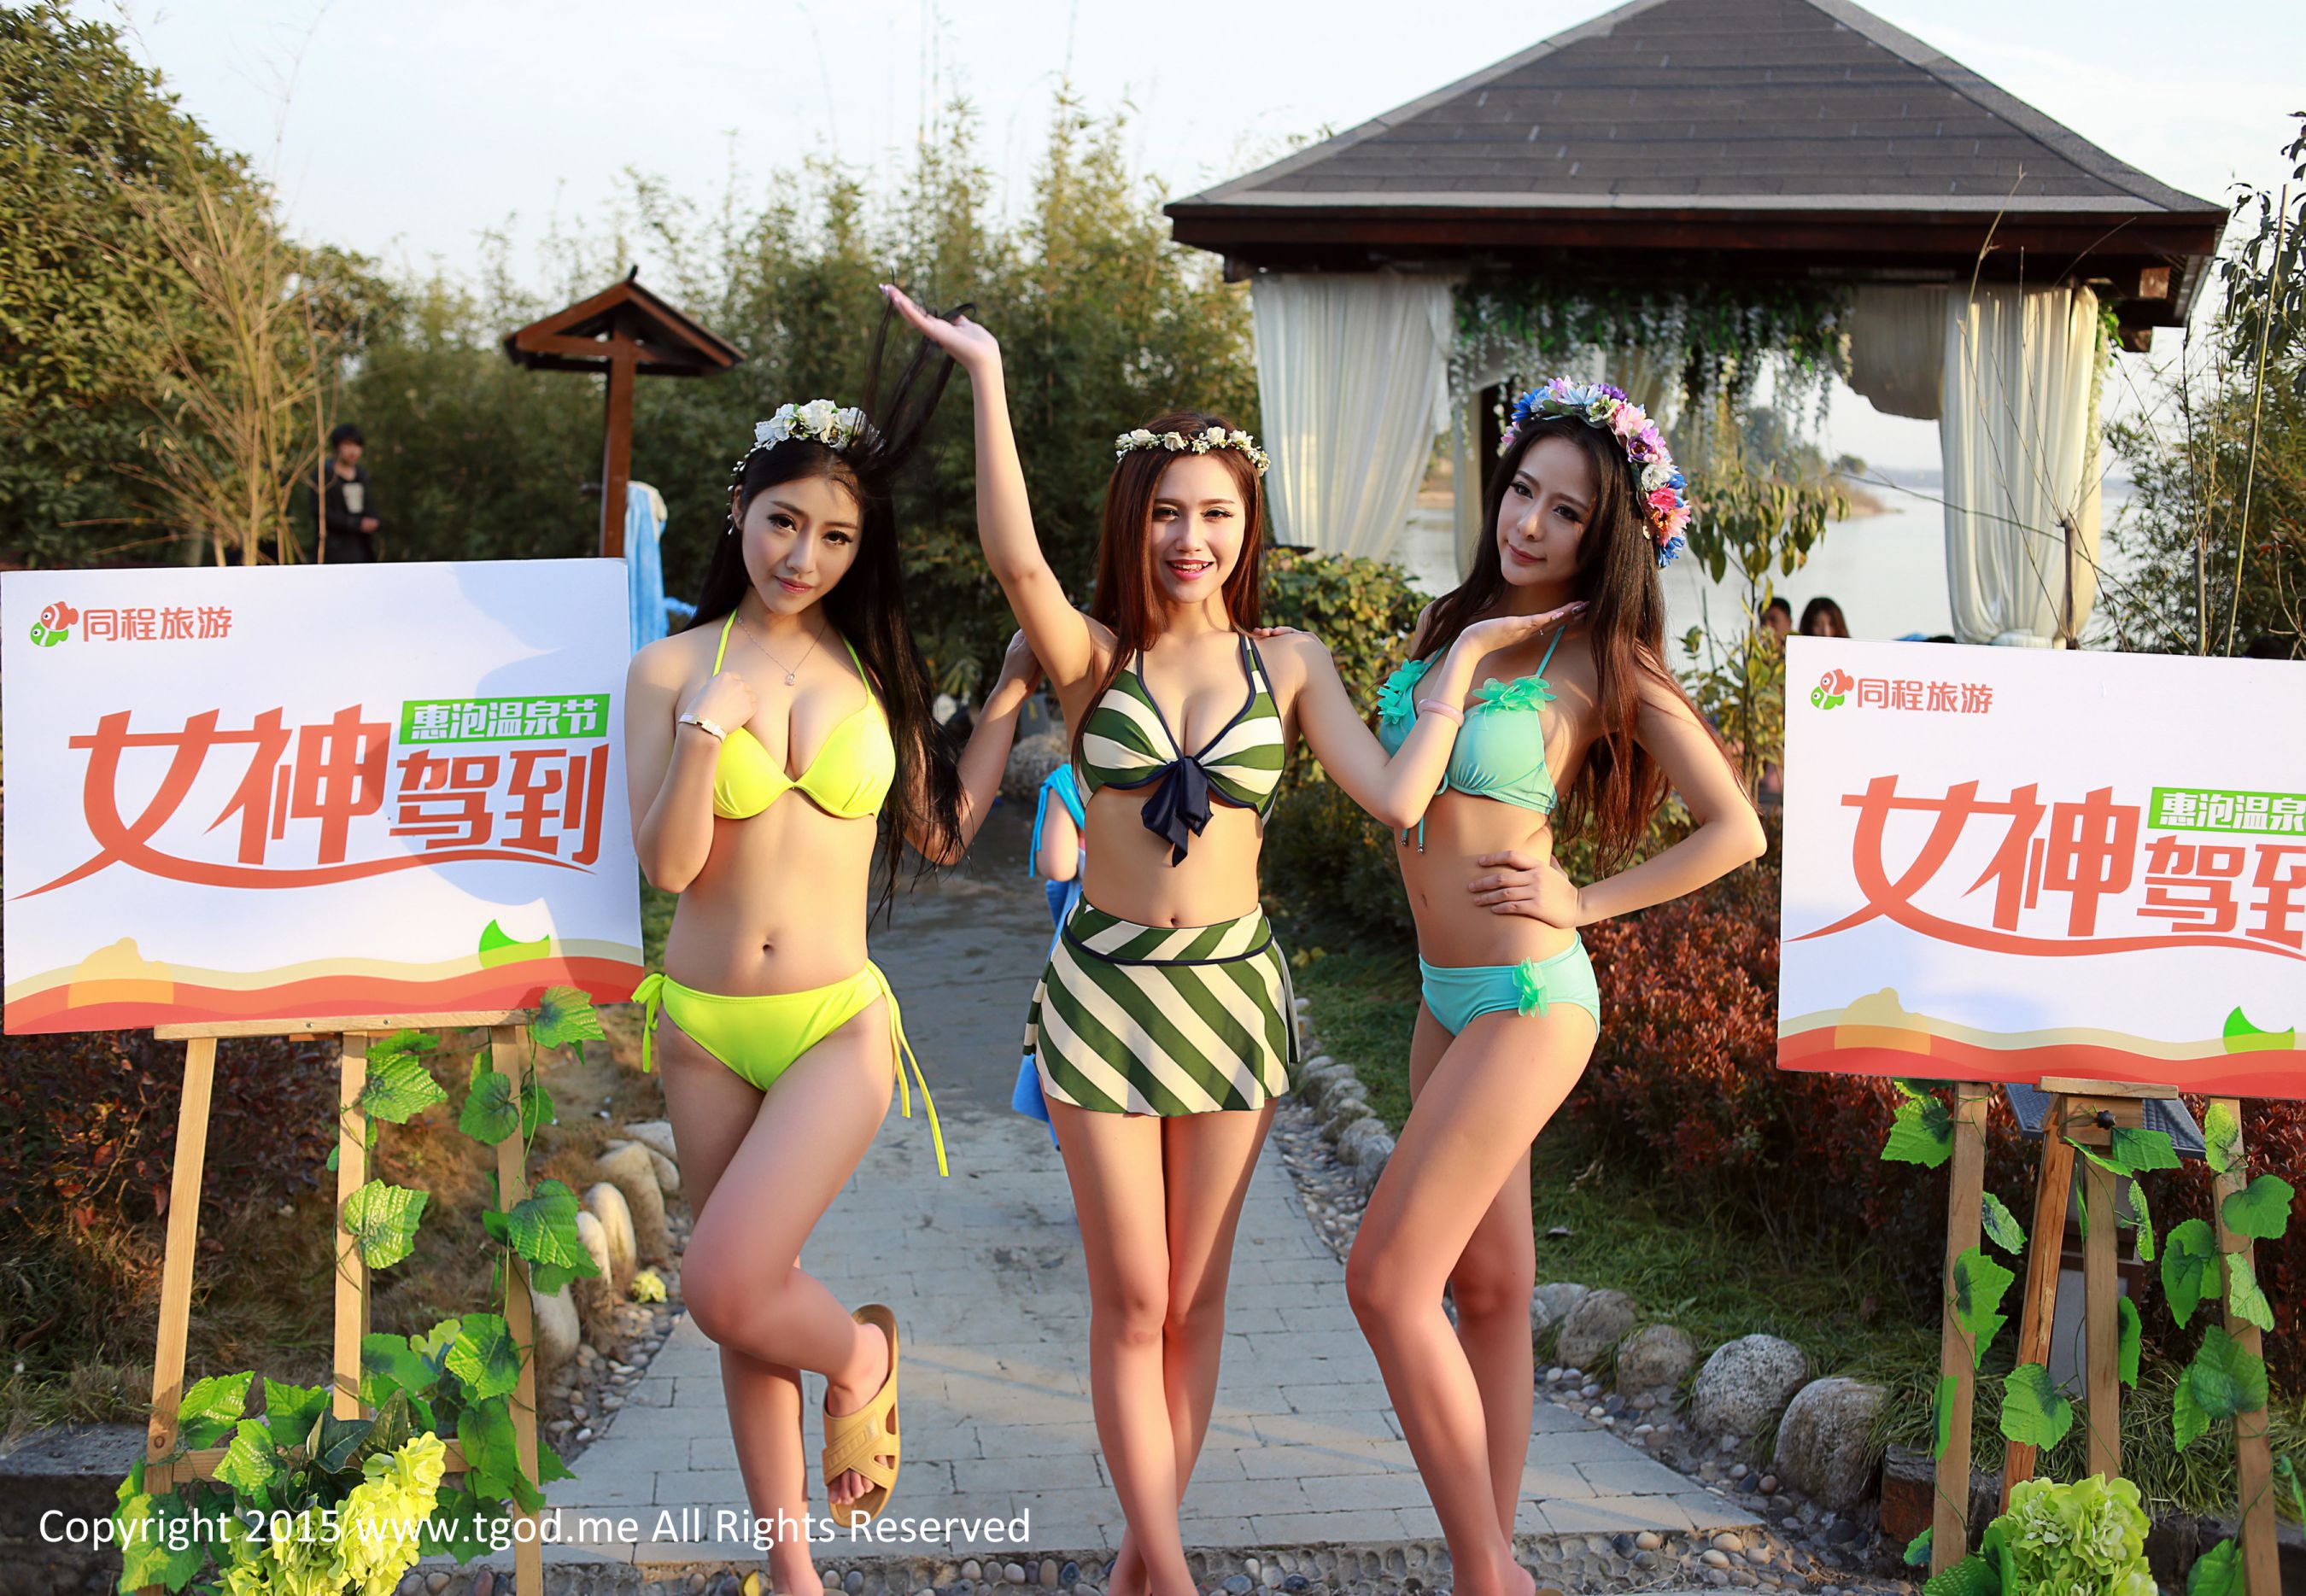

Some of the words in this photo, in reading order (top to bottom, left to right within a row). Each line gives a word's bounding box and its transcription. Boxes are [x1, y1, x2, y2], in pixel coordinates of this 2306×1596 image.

[83, 605, 233, 643] 同程旅游
[1857, 677, 1993, 715] 同程旅游
[411, 699, 599, 740] 惠泡温泉节
[7, 704, 610, 902] 女神驾到
